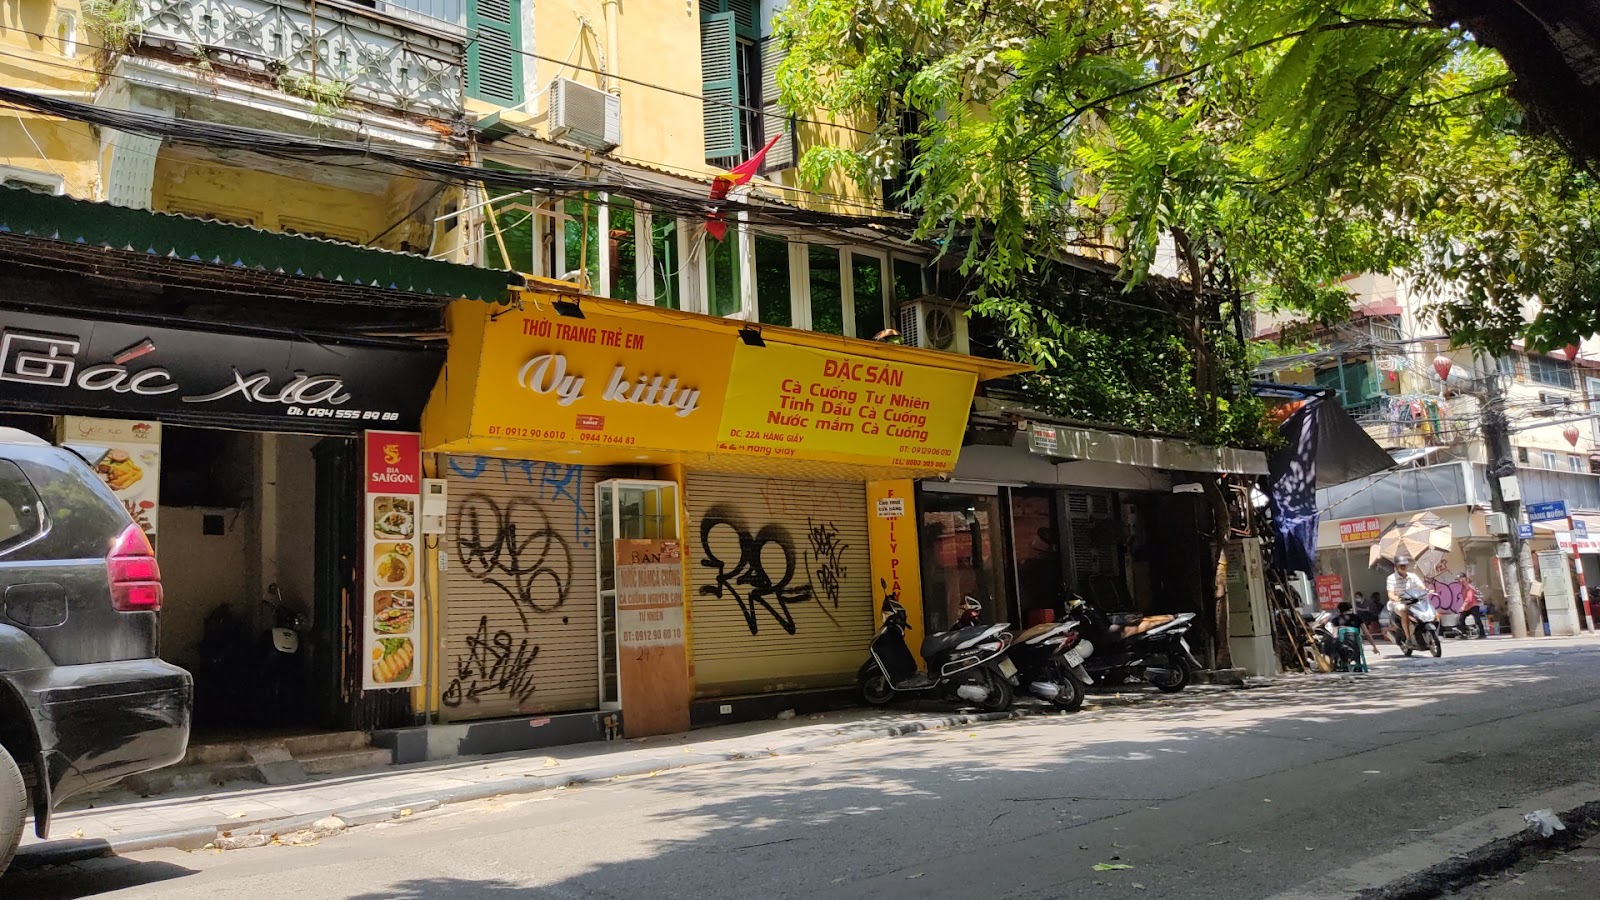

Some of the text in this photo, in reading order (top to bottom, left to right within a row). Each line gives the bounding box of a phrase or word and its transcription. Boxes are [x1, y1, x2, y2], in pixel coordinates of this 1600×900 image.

[523, 317, 645, 350] THỜI TRANG TRẺ EM
[823, 358, 904, 387] ĐẶC SẢN
[602, 365, 701, 417] kitty
[781, 378, 930, 410] Cà Cuống Tự Nhiên
[307, 407, 334, 417] 094
[335, 409, 361, 419] 555
[362, 410, 380, 420] 89
[381, 412, 399, 421] 88
[766, 410, 929, 442] Nước mắm Cà Cuống
[779, 395, 927, 427] Tinh Dầu Cà Cuống
[530, 428, 541, 437] 90
[543, 430, 566, 439] 6010
[580, 433, 600, 442] 0944
[603, 434, 623, 443] 7644
[625, 436, 635, 445] 83
[745, 430, 760, 439] 22A
[763, 431, 784, 442] HÀNG
[372, 472, 413, 483] SAIGON
